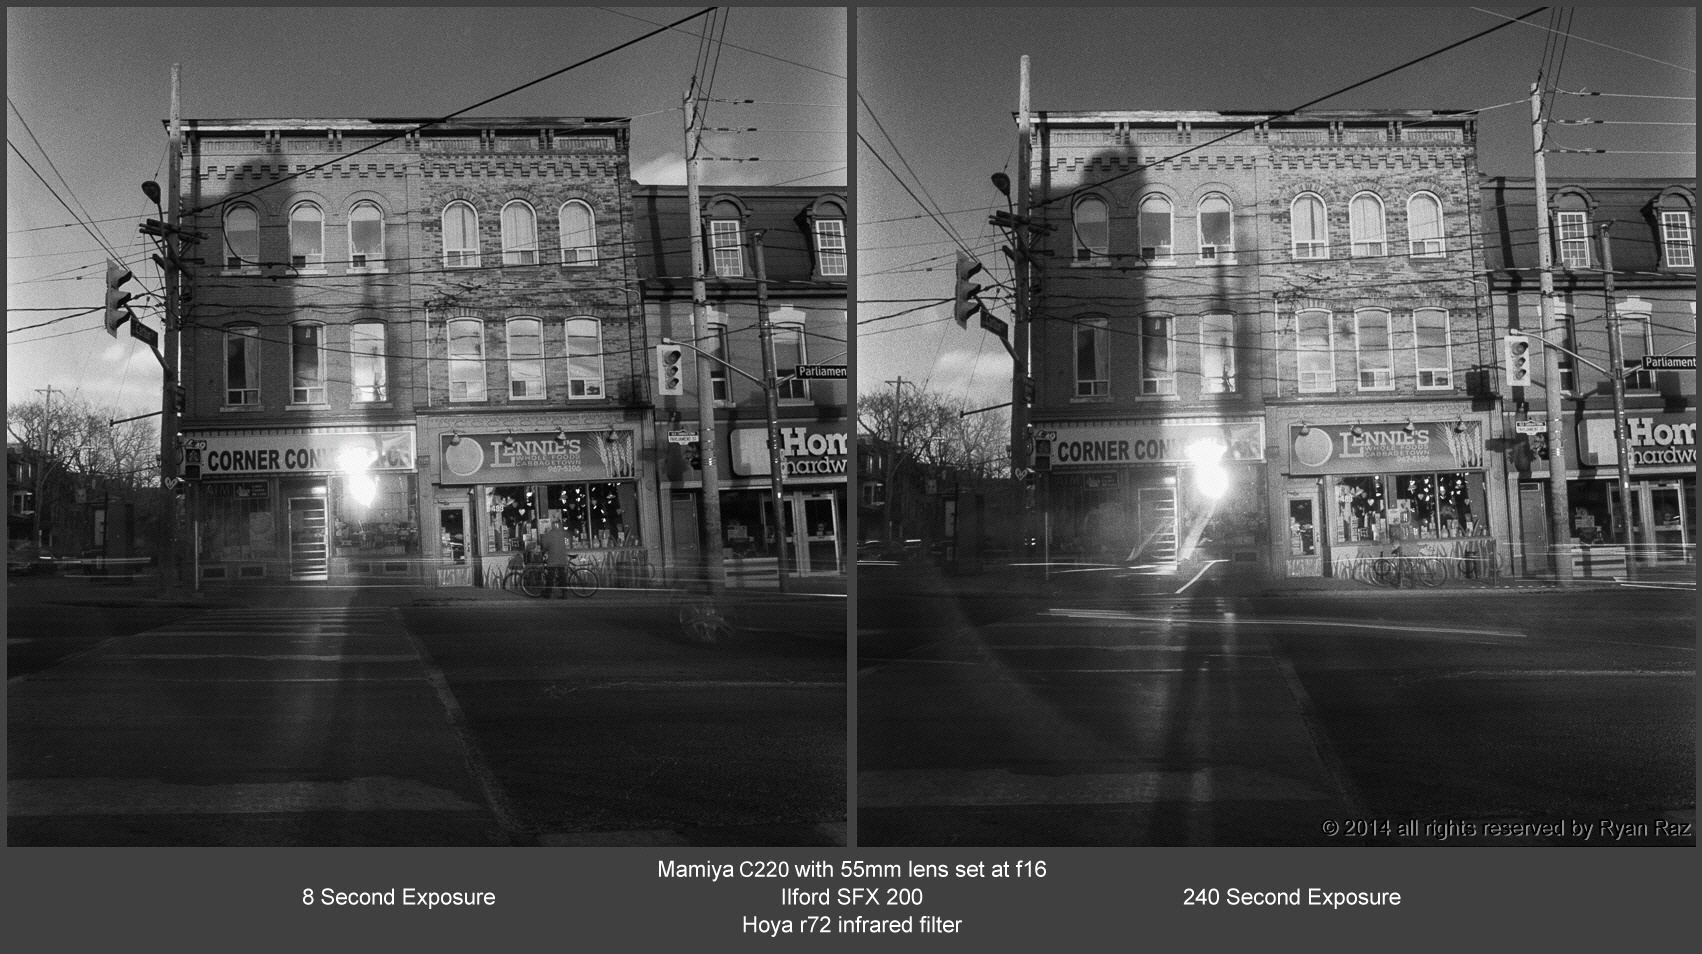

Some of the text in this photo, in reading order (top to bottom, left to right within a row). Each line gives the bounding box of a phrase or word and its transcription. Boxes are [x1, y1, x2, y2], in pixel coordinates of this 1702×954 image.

[1646, 357, 1696, 367] Parliament
[207, 449, 280, 471] CORNER
[1057, 440, 1130, 462] CORNER
[1633, 446, 1696, 464] hardw
[516, 459, 582, 467] CABBAGETOWN
